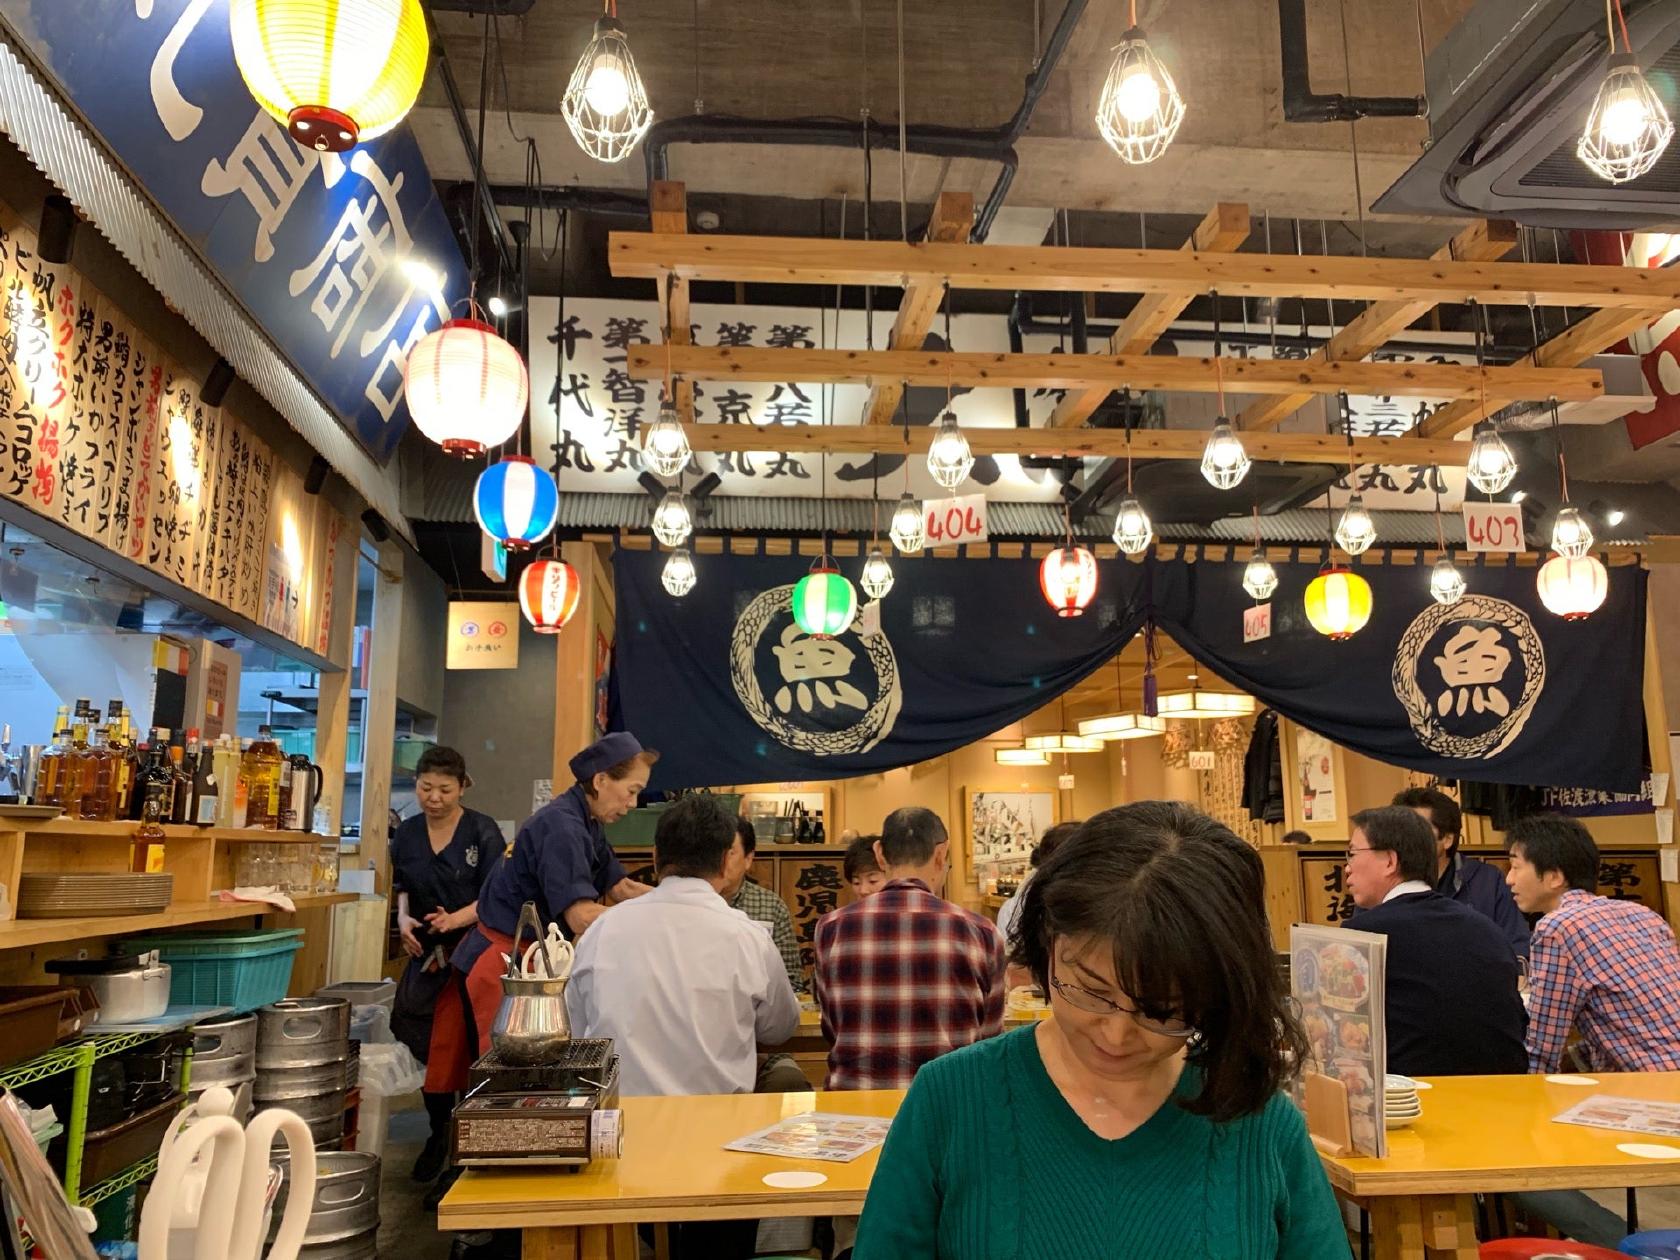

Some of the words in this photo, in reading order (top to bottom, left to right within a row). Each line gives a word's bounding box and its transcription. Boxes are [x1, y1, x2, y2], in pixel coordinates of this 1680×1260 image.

[59, 300, 95, 523] 特大ホッケ焼き
[547, 315, 594, 473] 千代丸
[927, 506, 982, 541] 404
[1433, 625, 1513, 718] 魚
